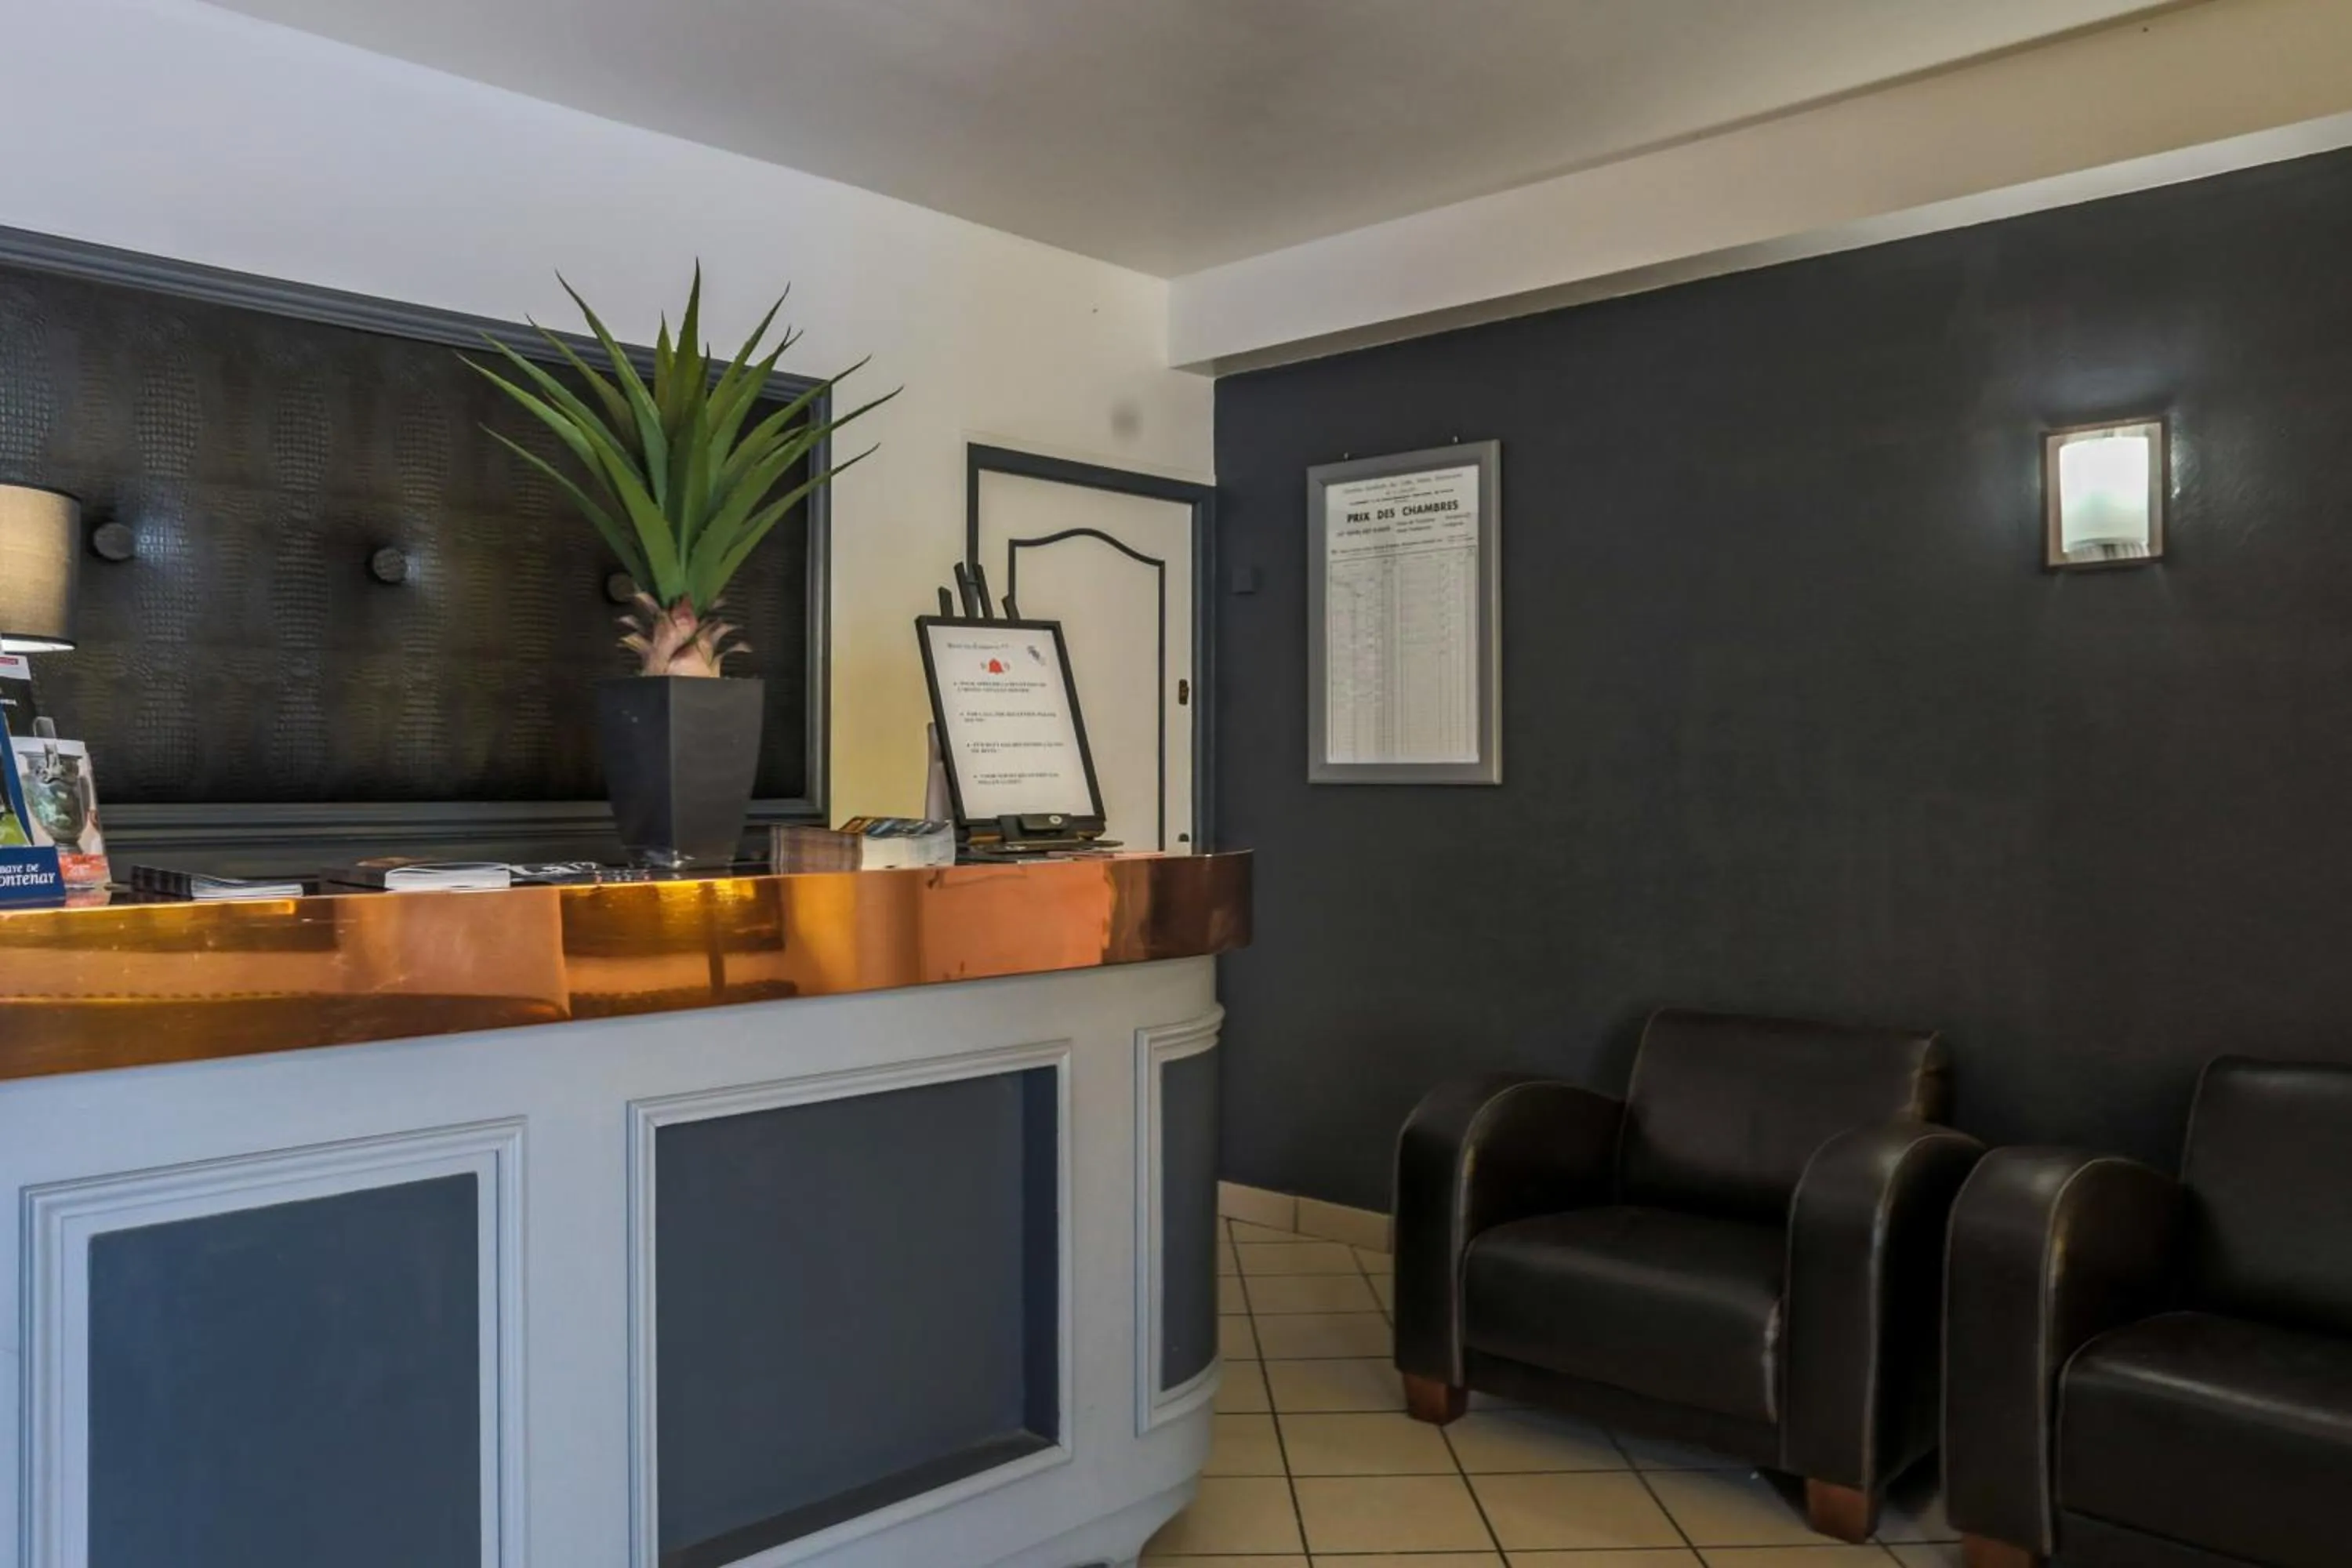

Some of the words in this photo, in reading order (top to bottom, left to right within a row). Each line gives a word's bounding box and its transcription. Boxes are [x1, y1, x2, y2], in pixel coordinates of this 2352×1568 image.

[1347, 512, 1370, 523] PRIX
[1377, 508, 1396, 520] DES
[1402, 499, 1459, 516] CHAMBRES
